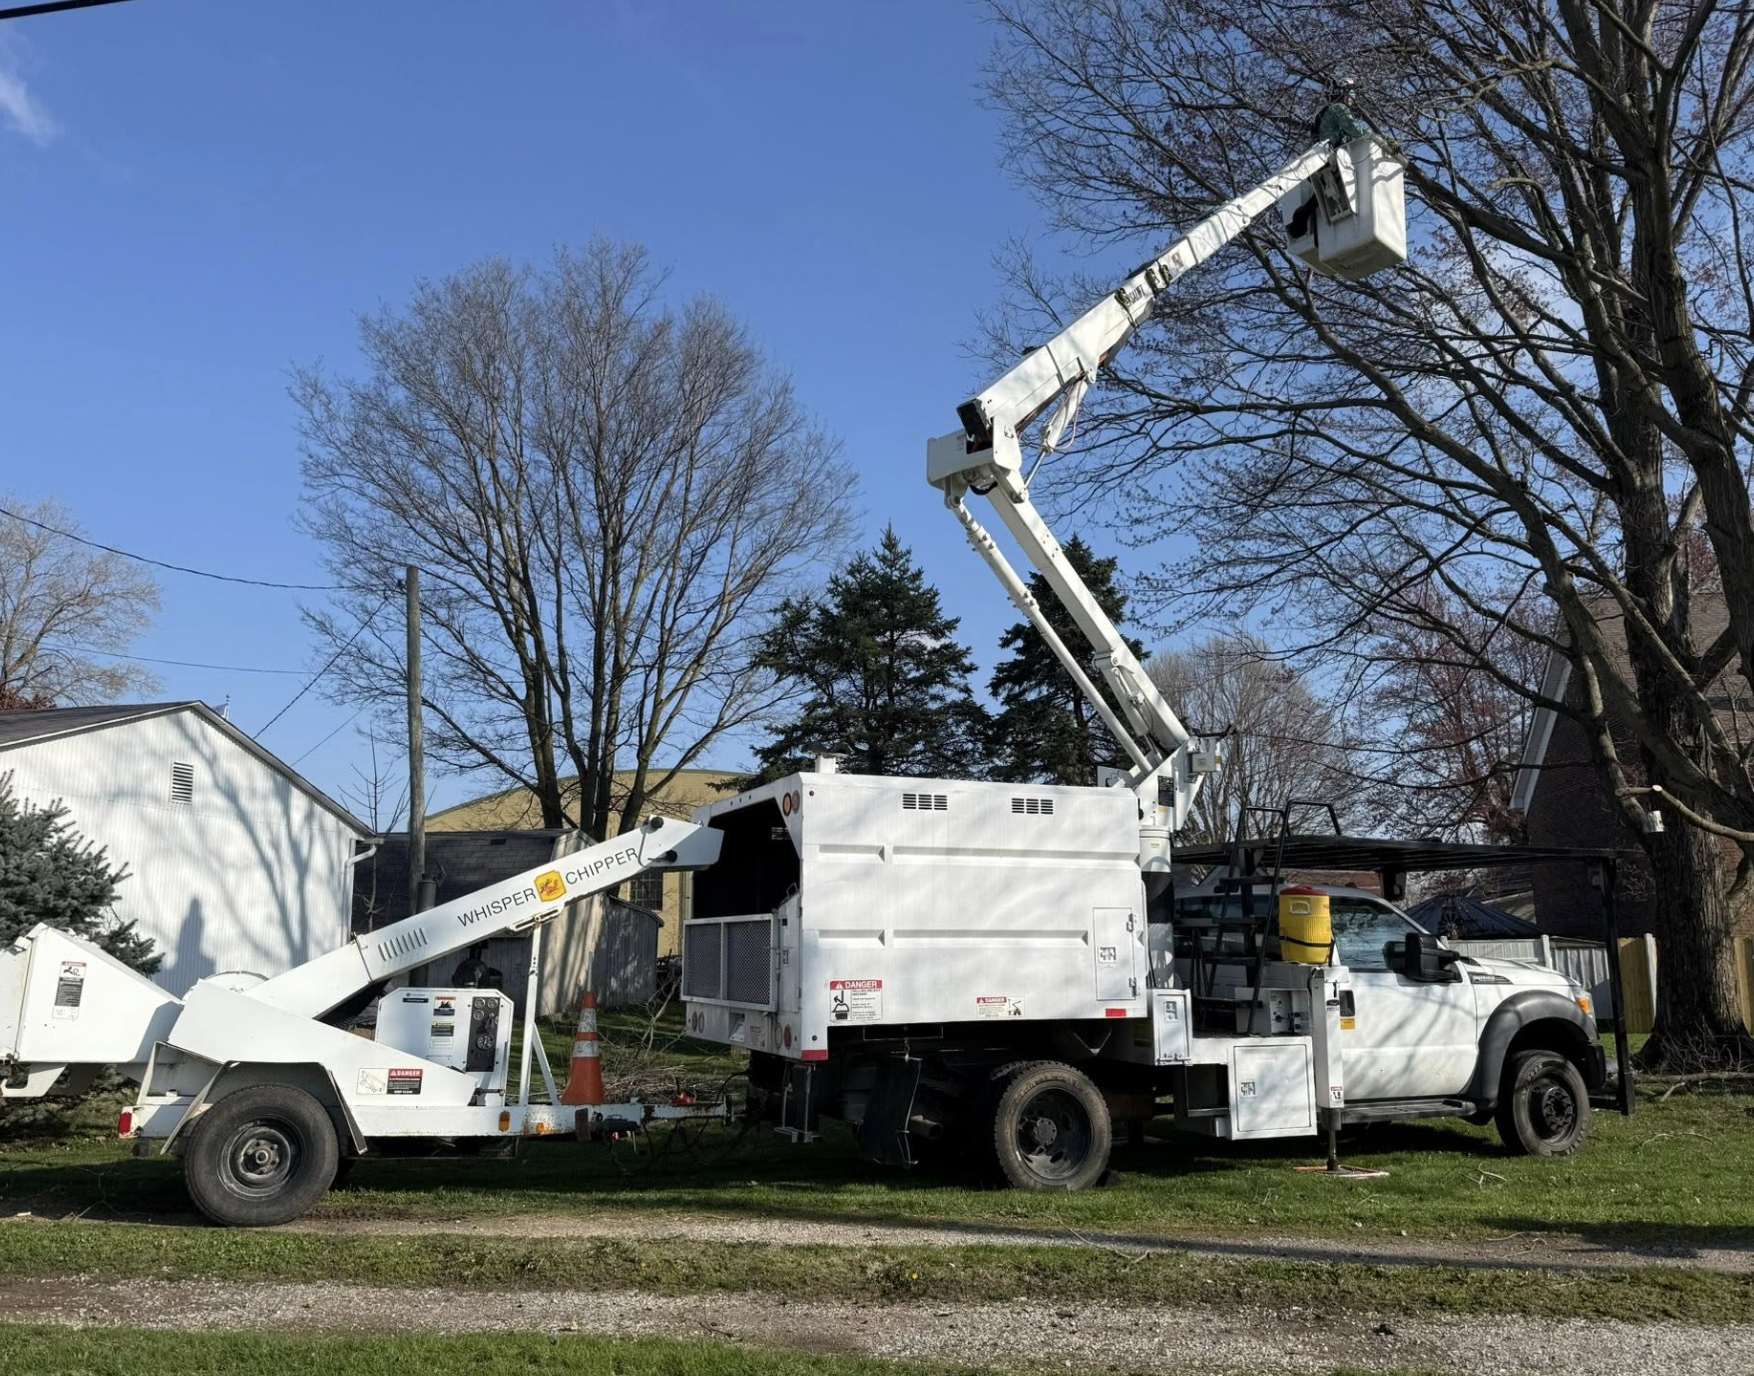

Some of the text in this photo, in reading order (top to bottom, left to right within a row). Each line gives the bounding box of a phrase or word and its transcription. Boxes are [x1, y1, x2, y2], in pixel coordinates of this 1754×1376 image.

[457, 847, 639, 927] WHISPER CHIPPER
[845, 980, 878, 989] DANGER
